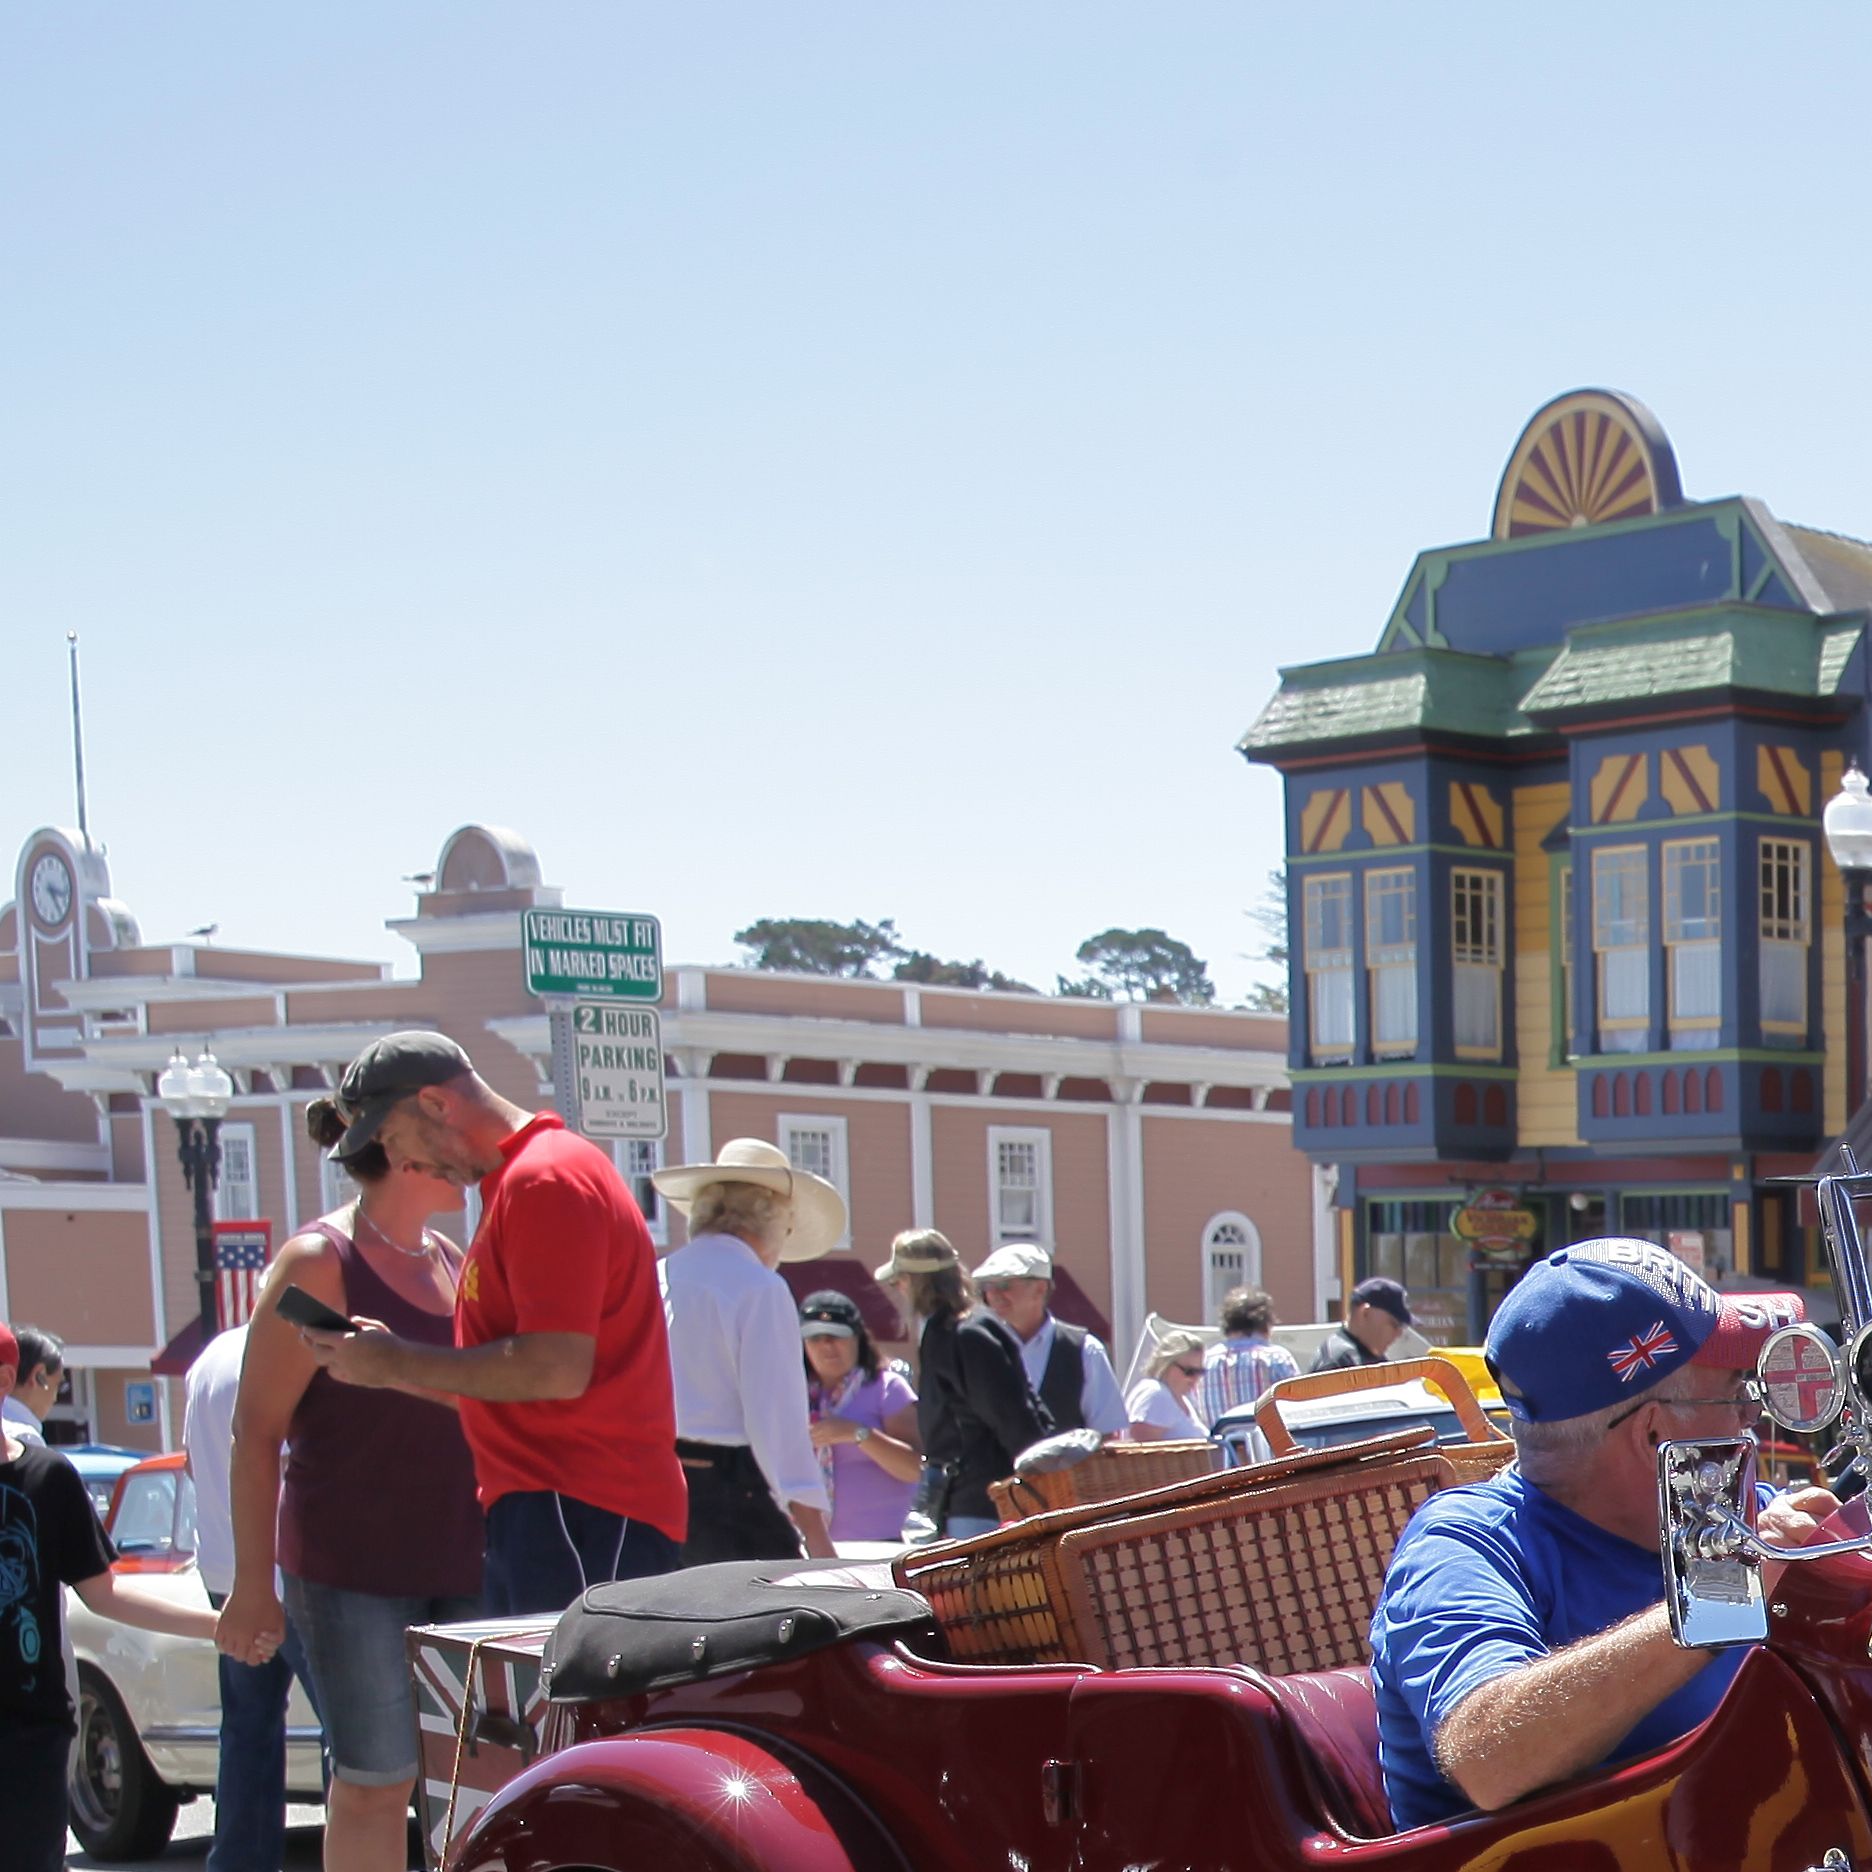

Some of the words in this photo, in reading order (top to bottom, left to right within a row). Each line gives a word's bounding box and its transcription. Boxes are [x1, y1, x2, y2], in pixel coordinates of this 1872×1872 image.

[530, 914, 591, 944] VEHICLES
[594, 918, 629, 947] MUST
[633, 920, 653, 947] FIT
[530, 948, 545, 976] IN
[549, 949, 606, 979] MARKED
[608, 952, 657, 981] SPACES
[581, 1008, 596, 1033] 2
[605, 1012, 653, 1038] HOUR
[580, 1044, 658, 1071] PARKING
[581, 1077, 591, 1101] 9
[629, 1079, 638, 1102] 6
[1607, 1238, 1798, 1332] BRITISH
